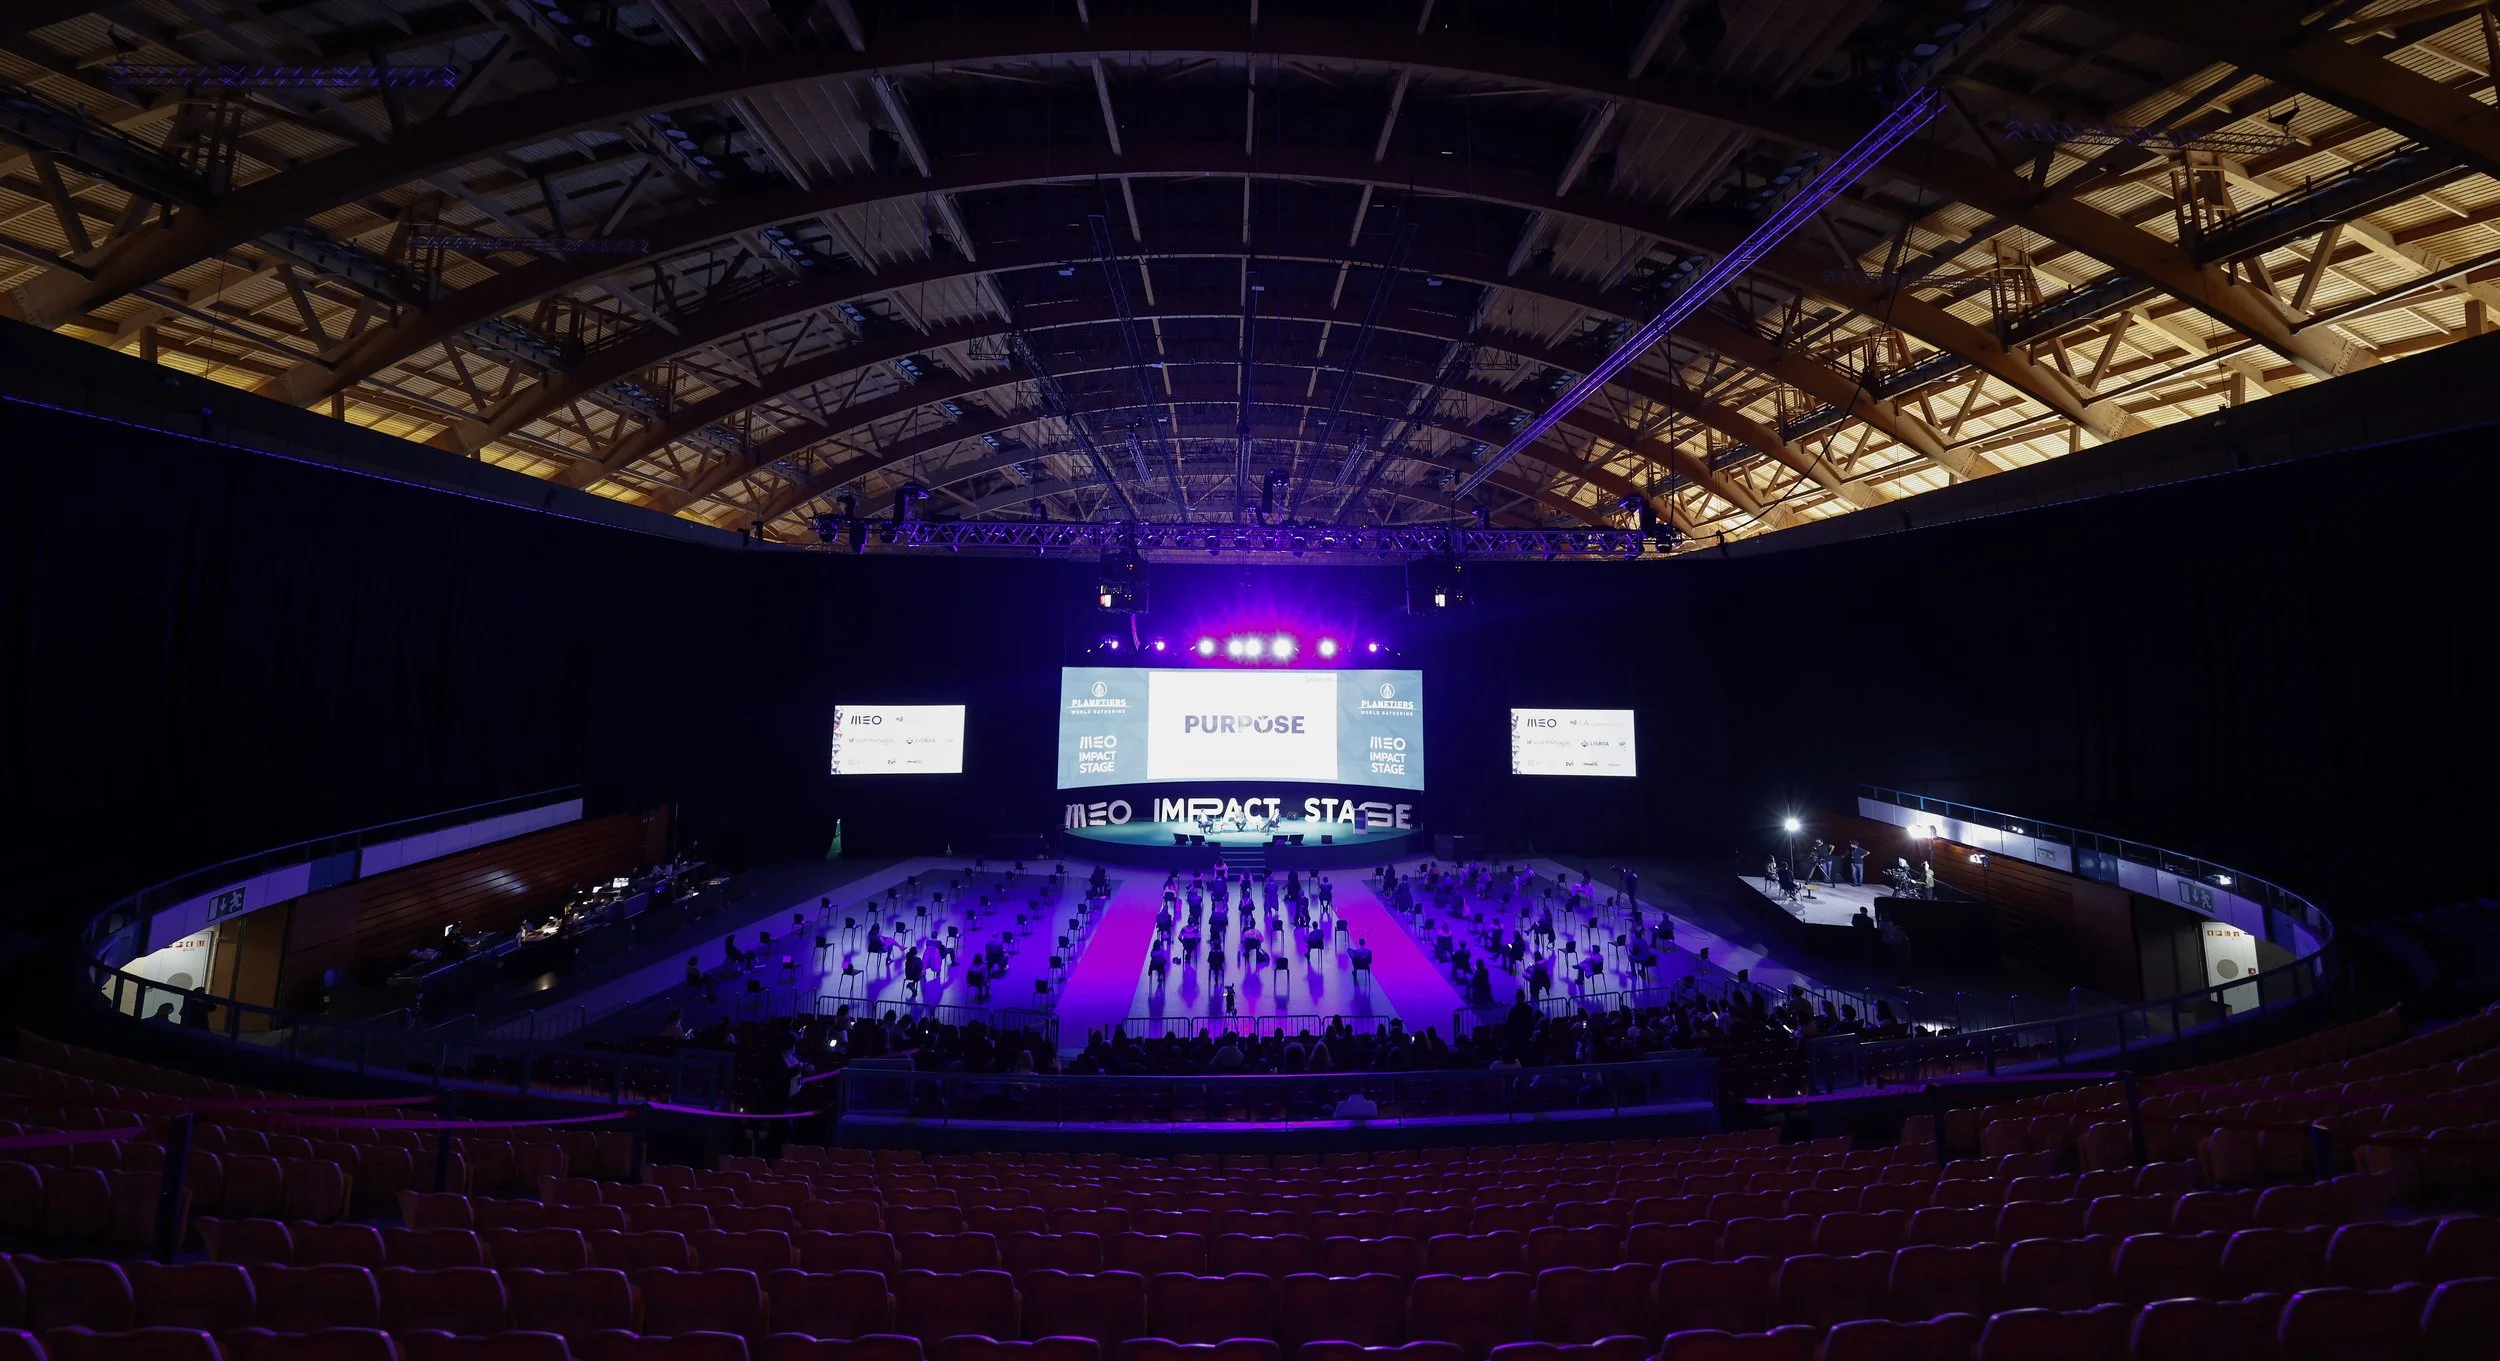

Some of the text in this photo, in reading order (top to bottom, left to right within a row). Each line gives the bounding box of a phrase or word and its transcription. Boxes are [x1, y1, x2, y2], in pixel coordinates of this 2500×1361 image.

[1071, 698, 1127, 707] PLANETIERS
[1361, 700, 1414, 709] PLANETIERS
[851, 715, 882, 725] MEO
[1185, 715, 1305, 734] PURPOSE
[1527, 718, 1557, 728] MEO
[1080, 735, 1117, 749] MEO
[1370, 736, 1406, 751] MEO
[1079, 751, 1117, 762] IMPACT
[1370, 752, 1406, 763] IMPACT
[1079, 762, 1115, 773] STAGE
[1371, 763, 1405, 775] STAGE
[1065, 797, 1413, 830] MEO IMPACT STAGE
